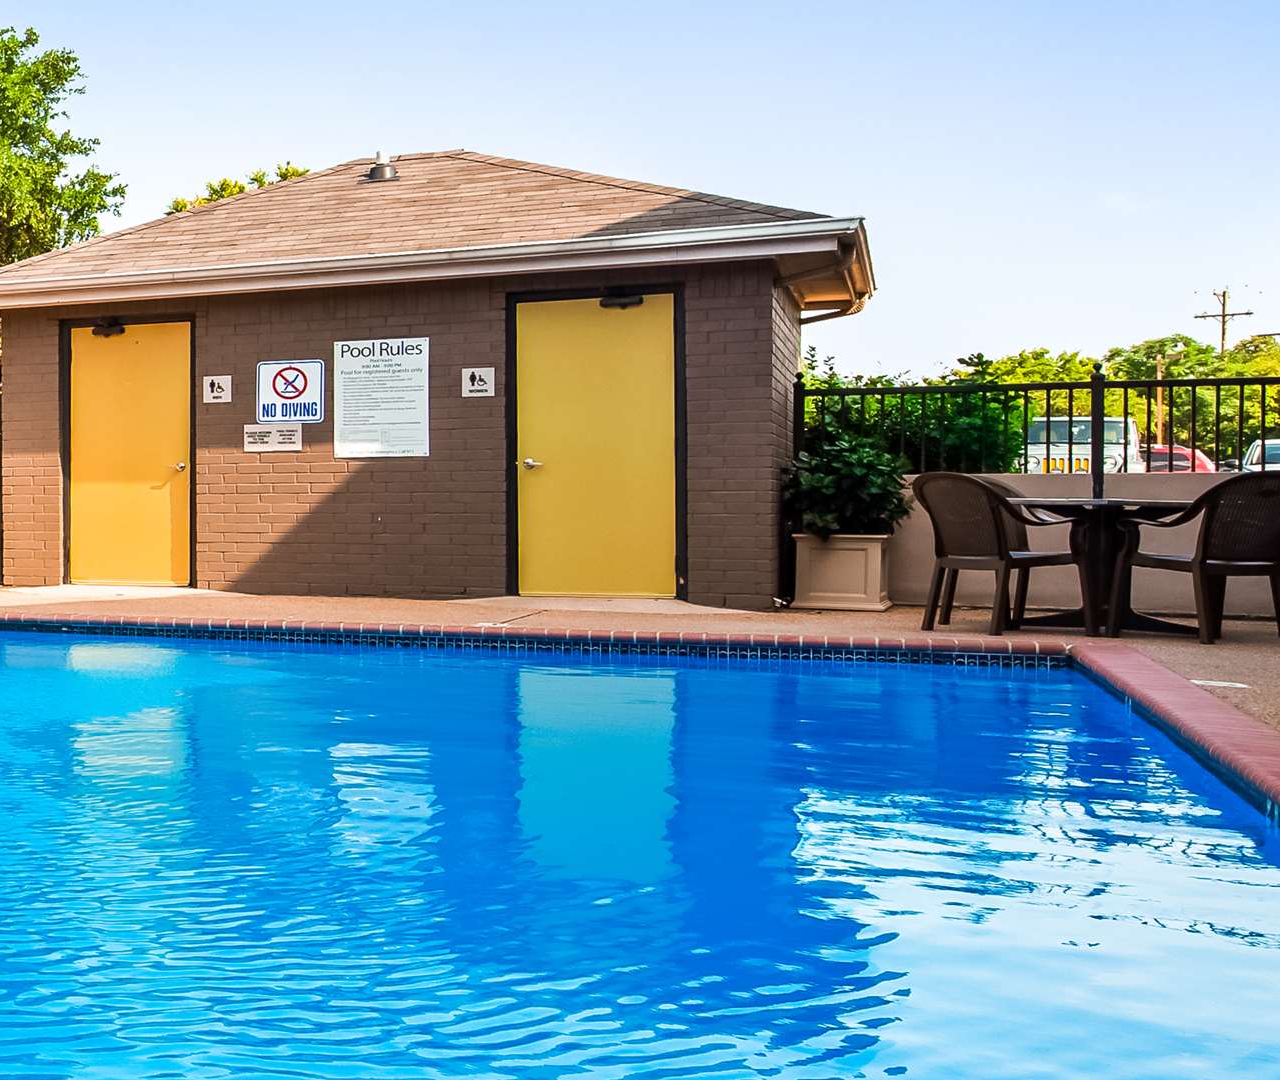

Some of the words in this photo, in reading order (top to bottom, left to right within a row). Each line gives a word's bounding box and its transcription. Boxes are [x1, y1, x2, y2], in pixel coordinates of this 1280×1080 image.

[340, 342, 375, 358] Pool
[380, 341, 423, 356] Rules
[262, 403, 277, 418] NO
[281, 402, 317, 417] DIVING
